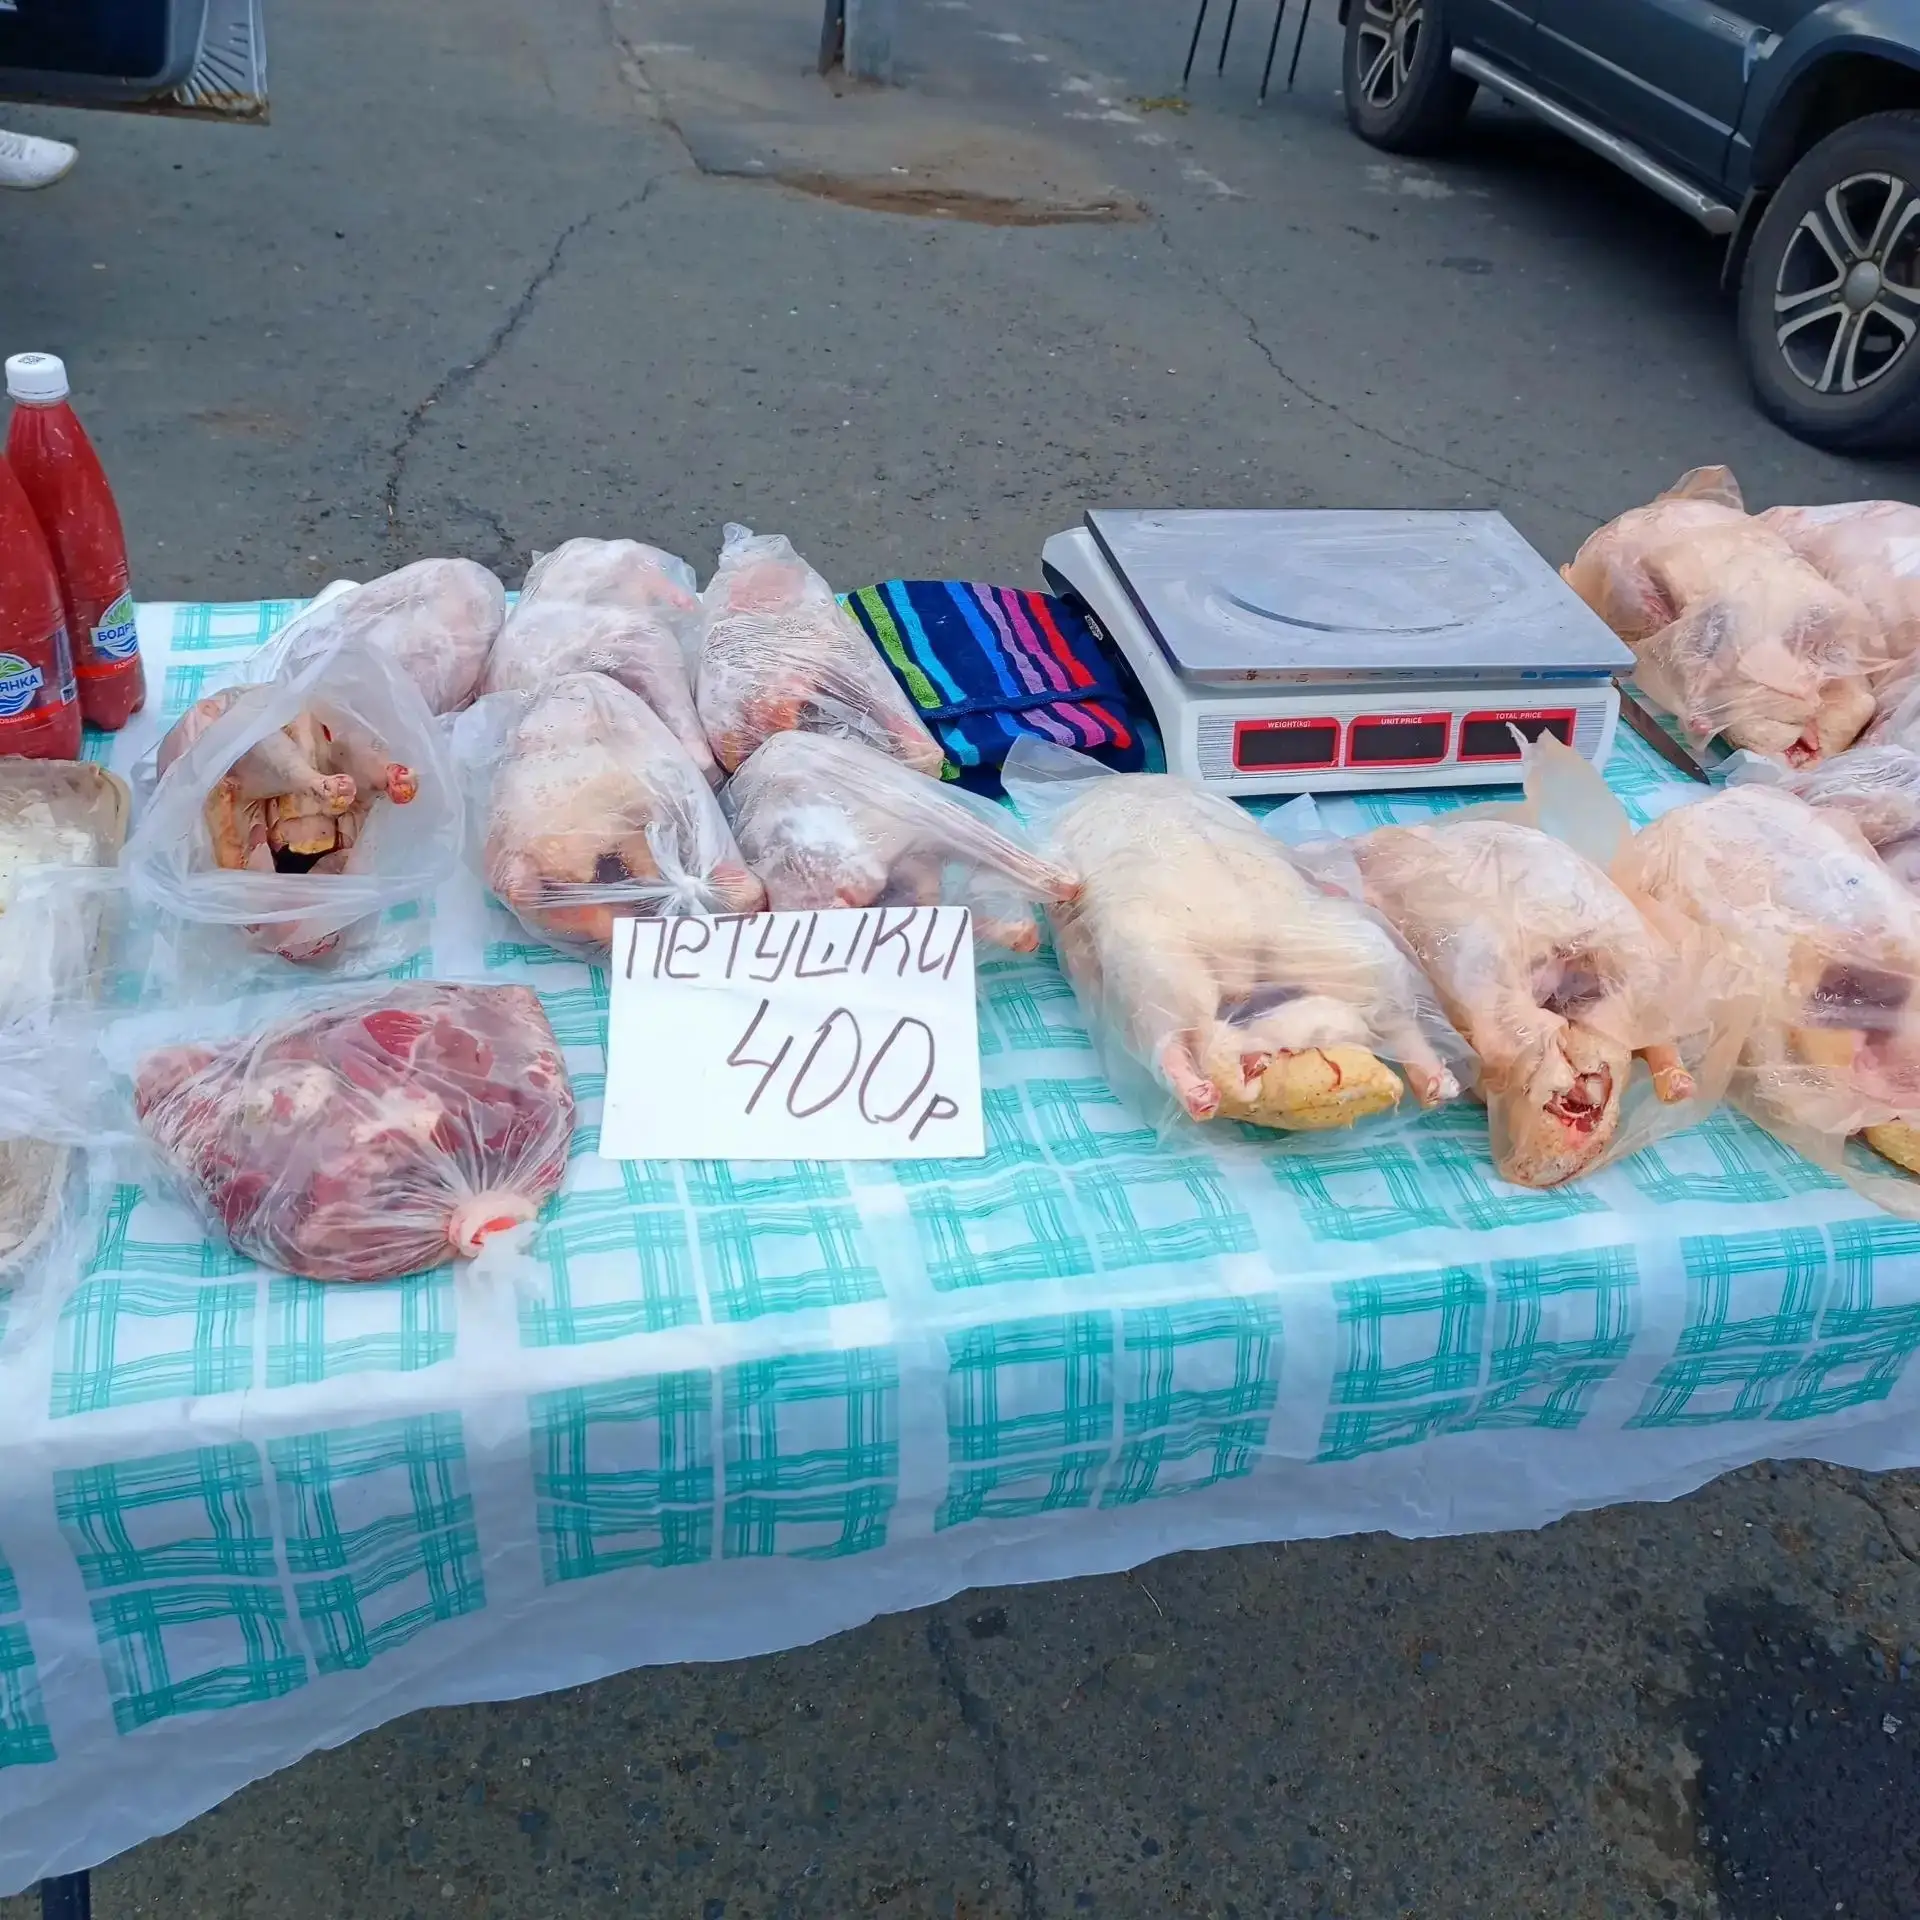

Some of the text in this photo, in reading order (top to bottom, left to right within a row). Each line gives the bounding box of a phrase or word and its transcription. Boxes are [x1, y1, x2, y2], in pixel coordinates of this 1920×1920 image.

[1495, 711, 1543, 720] TOTAL PRICE
[1381, 716, 1423, 726] UNIT PRICE
